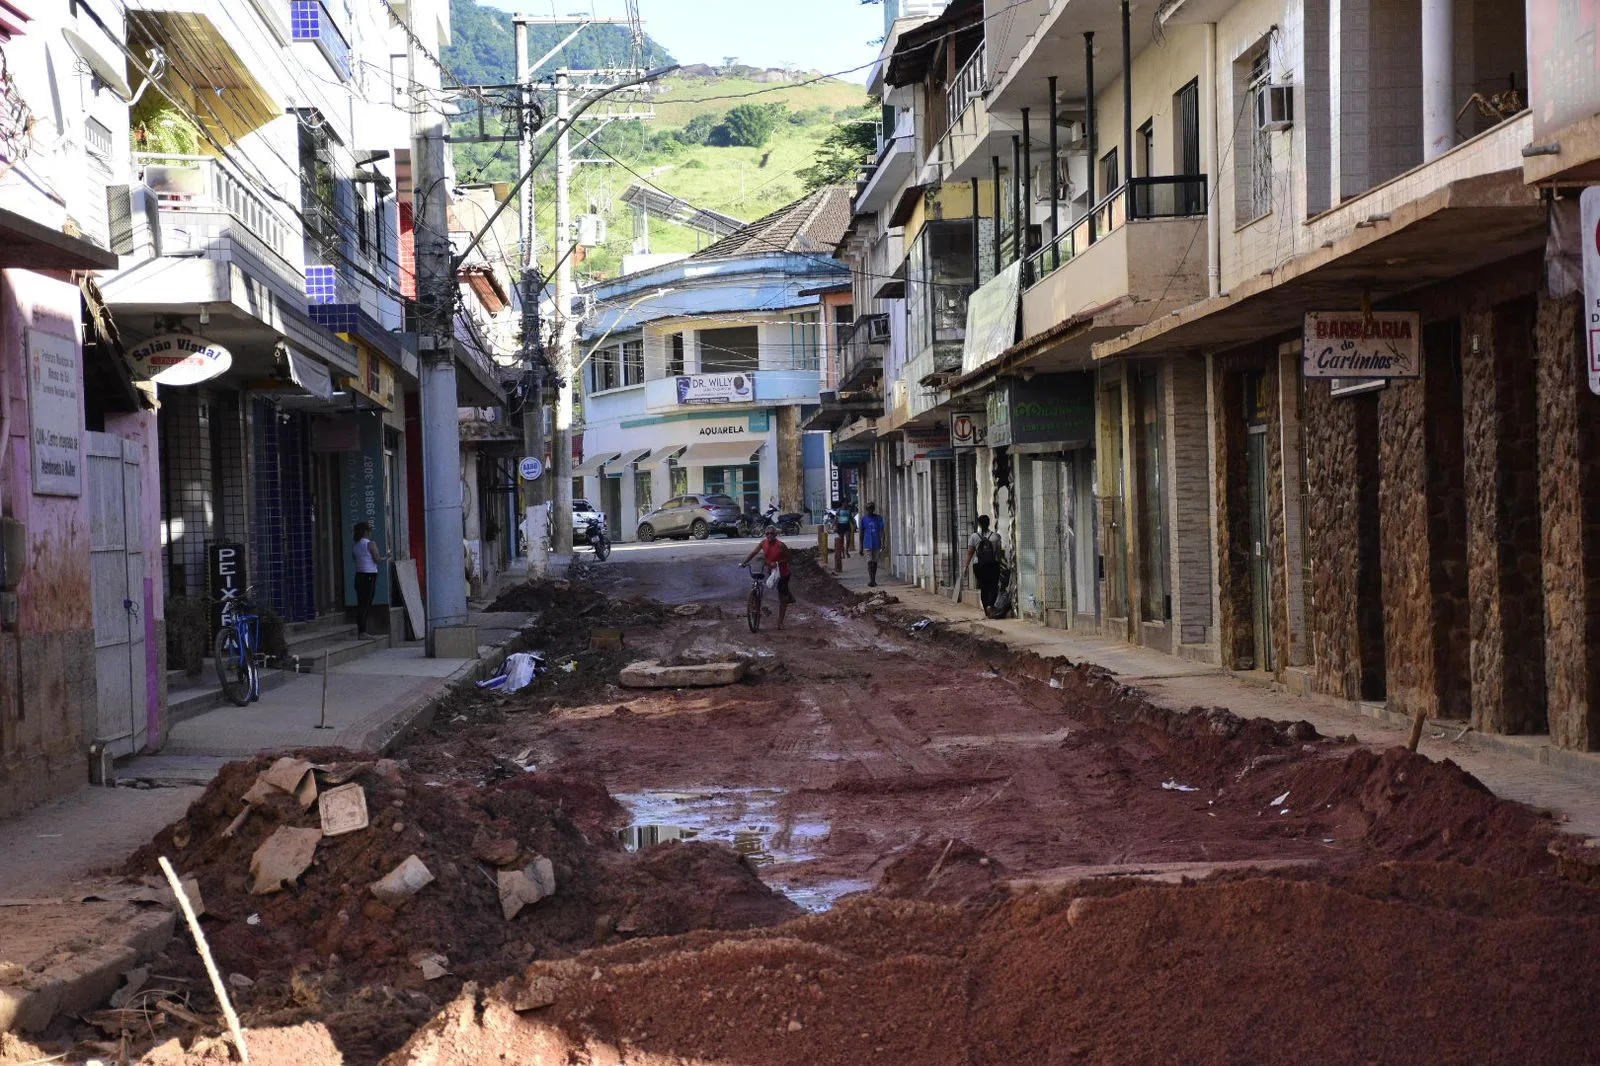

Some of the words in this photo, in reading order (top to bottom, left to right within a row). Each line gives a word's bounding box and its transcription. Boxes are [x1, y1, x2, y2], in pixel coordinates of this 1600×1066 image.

[132, 339, 171, 361] Salão
[177, 338, 221, 360] Visual
[1341, 340, 1354, 351] do
[1317, 347, 1392, 369] Carlinhos
[692, 379, 706, 388] DR.
[709, 377, 732, 387] WILLY
[700, 426, 744, 435] AQUARELA
